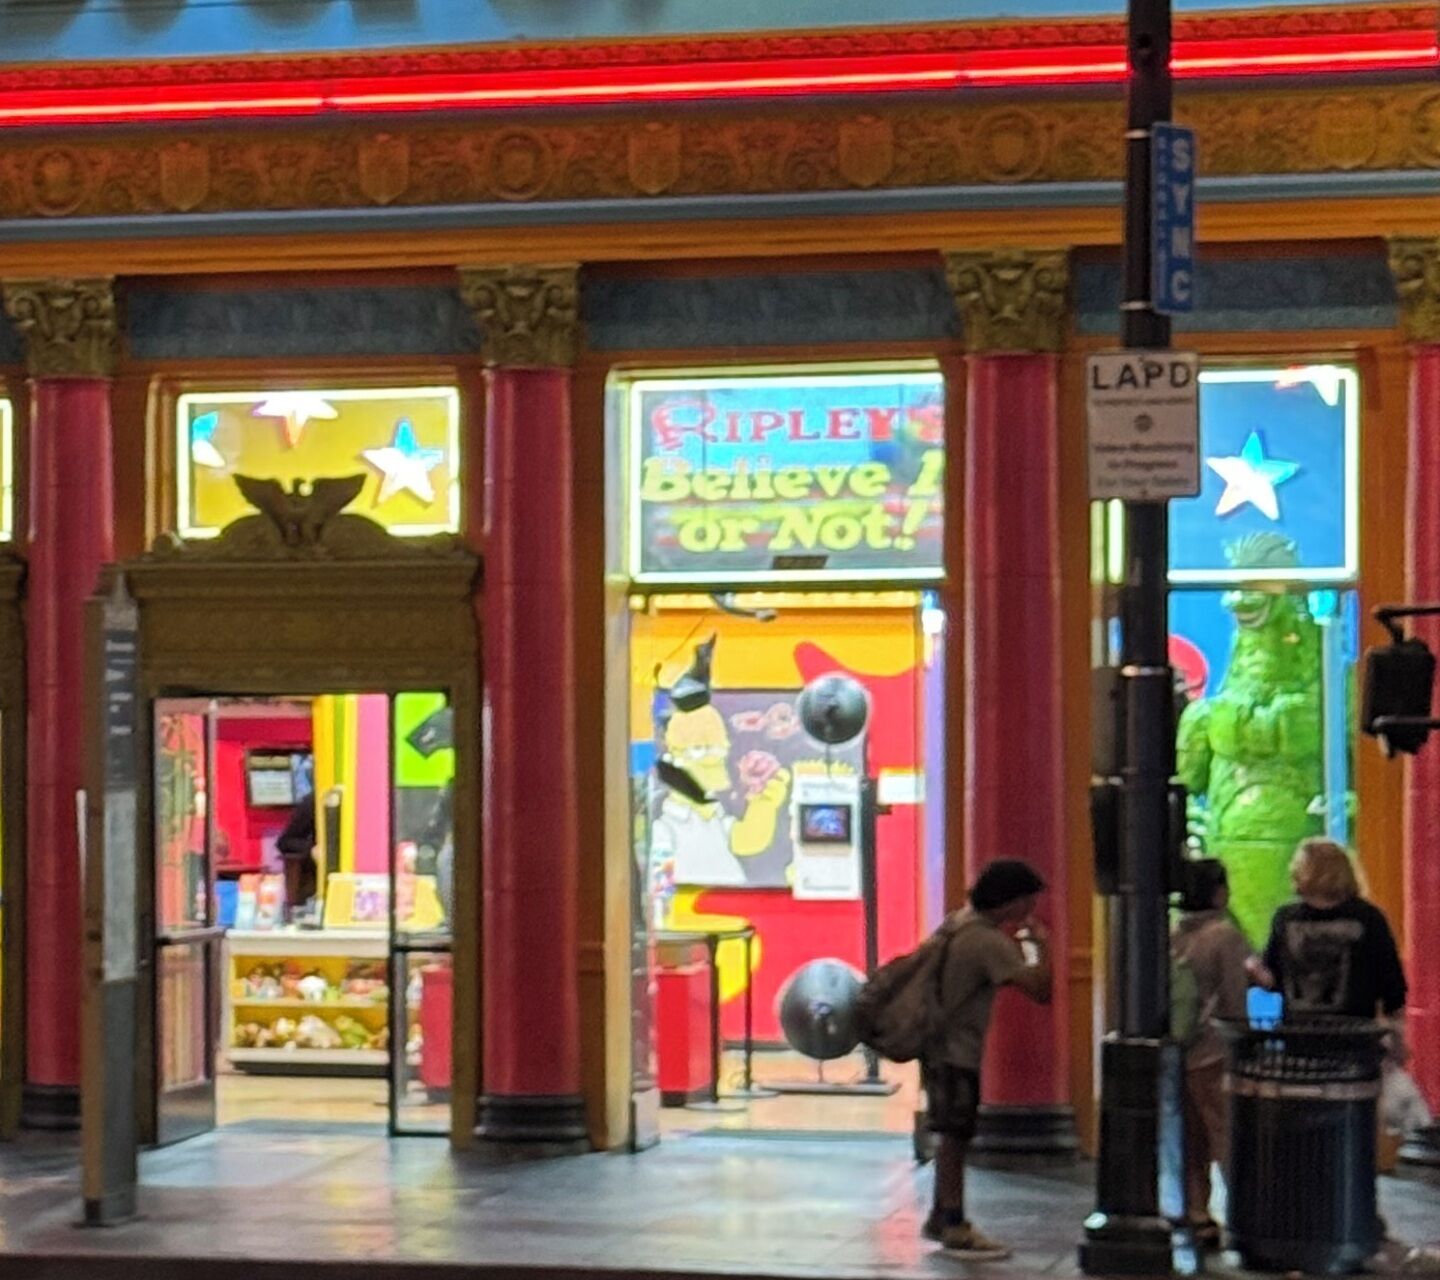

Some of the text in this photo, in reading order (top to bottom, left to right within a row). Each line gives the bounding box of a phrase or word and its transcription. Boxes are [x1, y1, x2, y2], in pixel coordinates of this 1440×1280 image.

[1092, 361, 1191, 390] LAPD
[640, 456, 892, 501] Believe
[678, 500, 928, 552] or Not!
